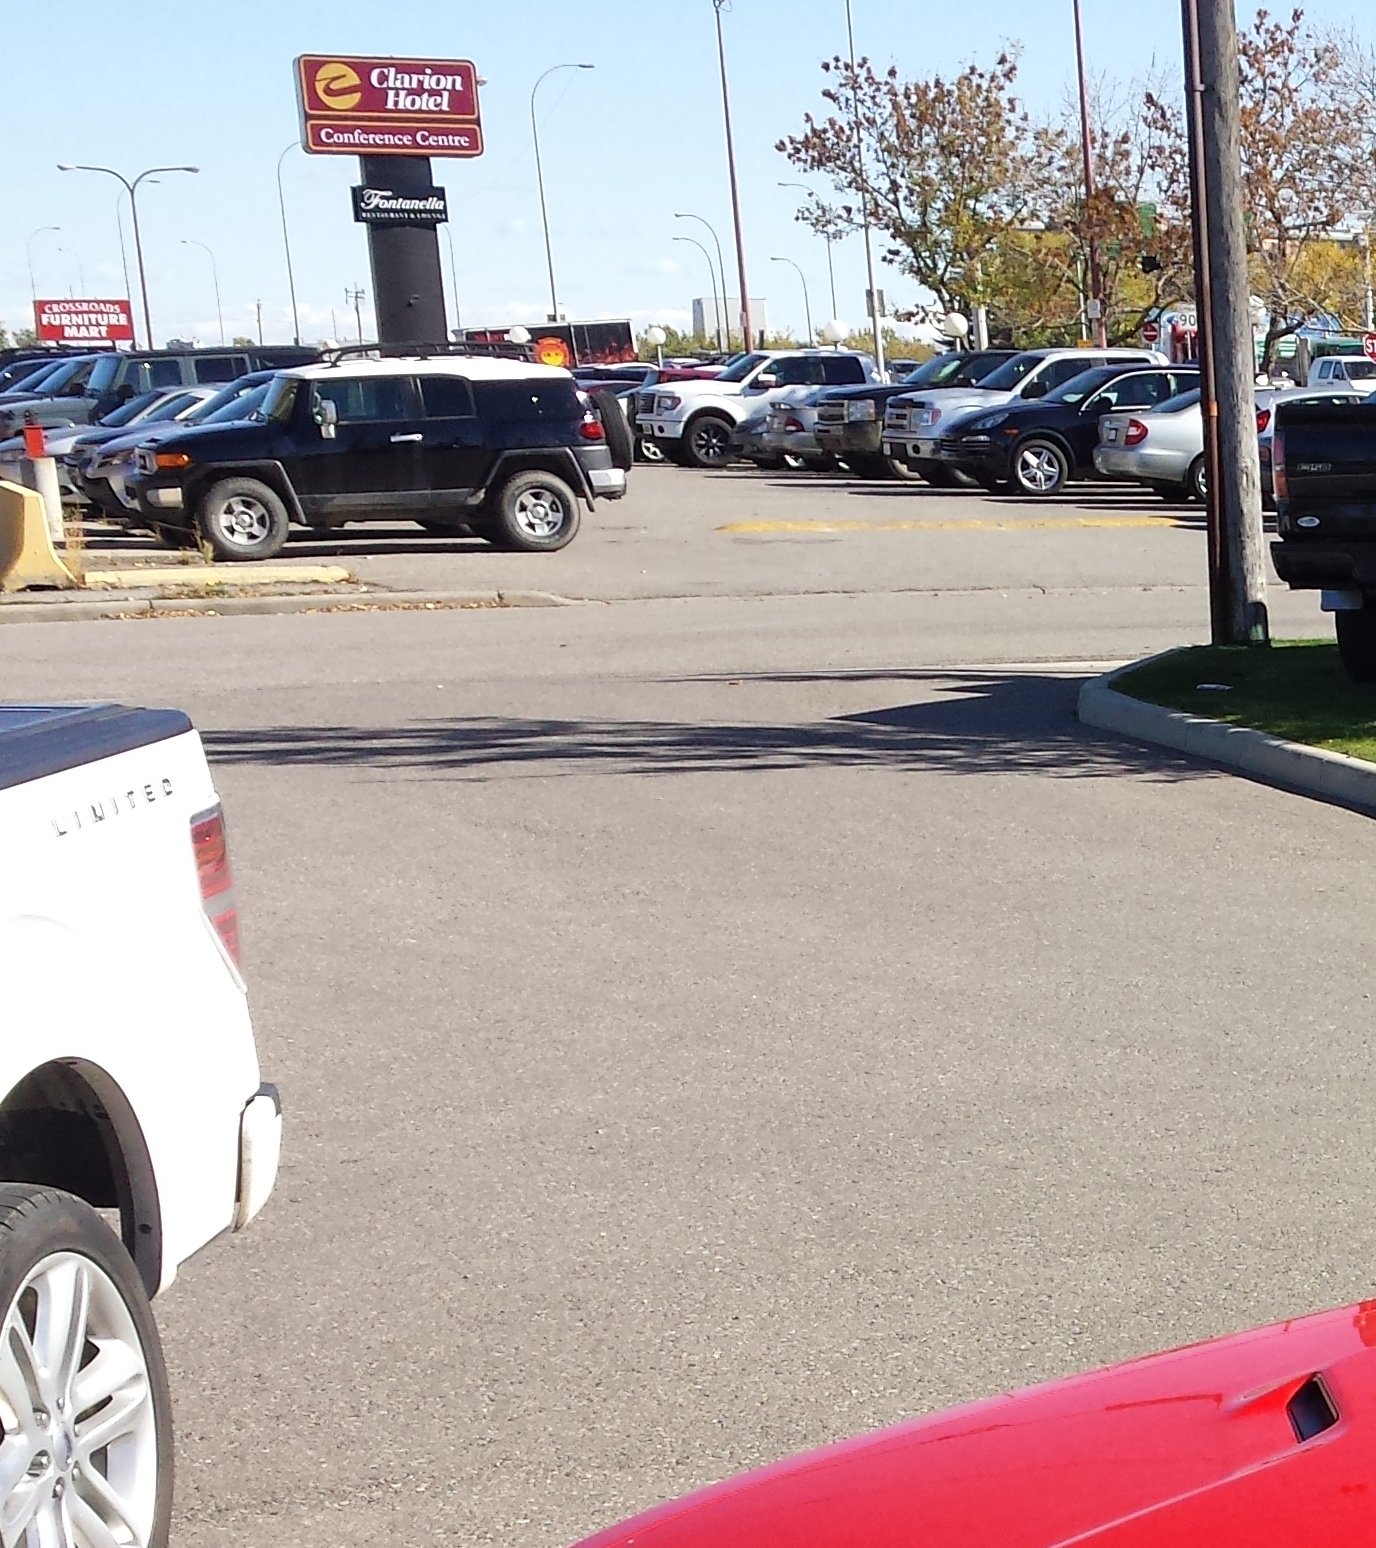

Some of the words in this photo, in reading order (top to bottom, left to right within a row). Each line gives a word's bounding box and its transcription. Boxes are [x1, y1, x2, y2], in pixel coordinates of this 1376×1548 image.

[370, 67, 463, 91] Clarion
[385, 90, 451, 111] Hotel
[319, 128, 412, 145] Conference
[416, 130, 470, 146] Centre
[360, 188, 444, 210] Fontanella
[44, 302, 120, 313] CROSSROADS
[41, 313, 128, 326] FURNITURE
[1179, 314, 1197, 327] 90
[64, 325, 108, 338] MART
[51, 777, 174, 838] LIMITED
